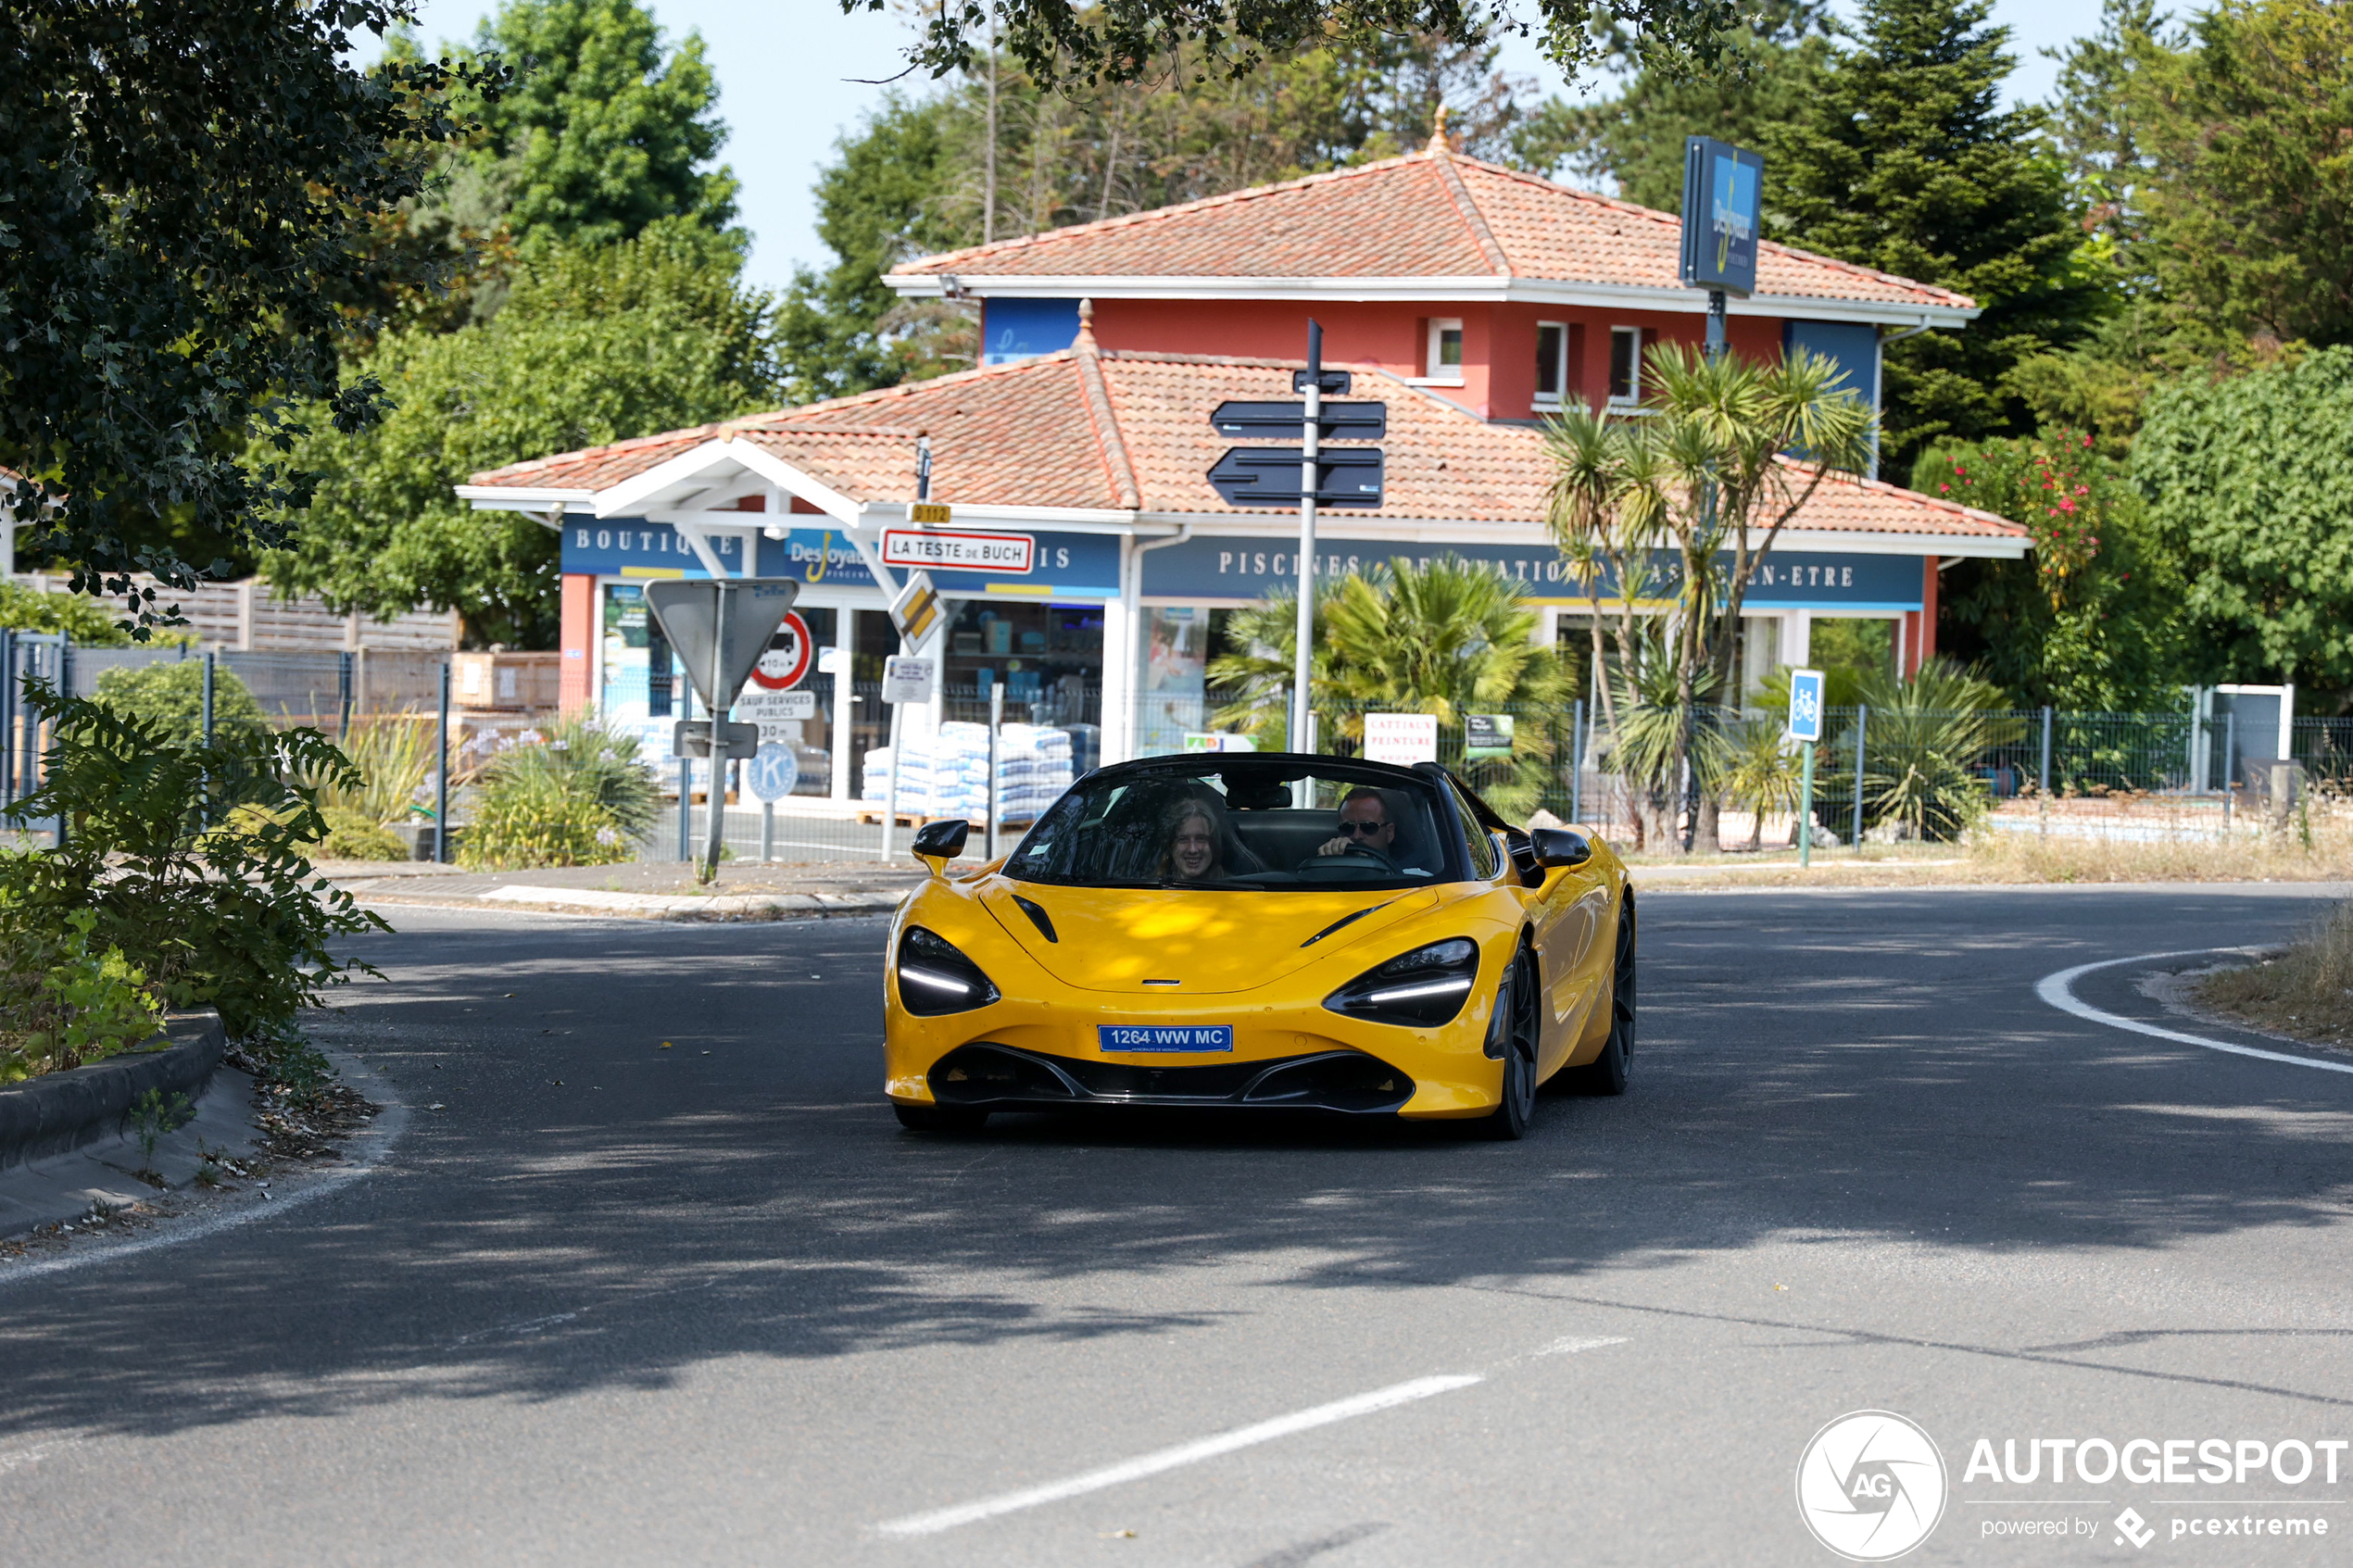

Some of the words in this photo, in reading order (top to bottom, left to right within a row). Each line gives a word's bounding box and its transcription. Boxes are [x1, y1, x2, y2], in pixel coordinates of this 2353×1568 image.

[914, 508, 921, 520] D
[926, 508, 947, 521] 112
[576, 529, 734, 556] BOUTIQE
[892, 540, 910, 555] LA
[916, 542, 962, 558] TESTE
[983, 546, 1022, 560] BUCH
[740, 696, 763, 707] SAUF
[767, 695, 811, 705] SERVICES
[756, 707, 794, 717] PUBLICS
[761, 725, 776, 736] 30
[761, 755, 783, 788] K
[1112, 1030, 1150, 1044] 1264
[1155, 1030, 1190, 1044] WW
[1196, 1030, 1223, 1044] MC
